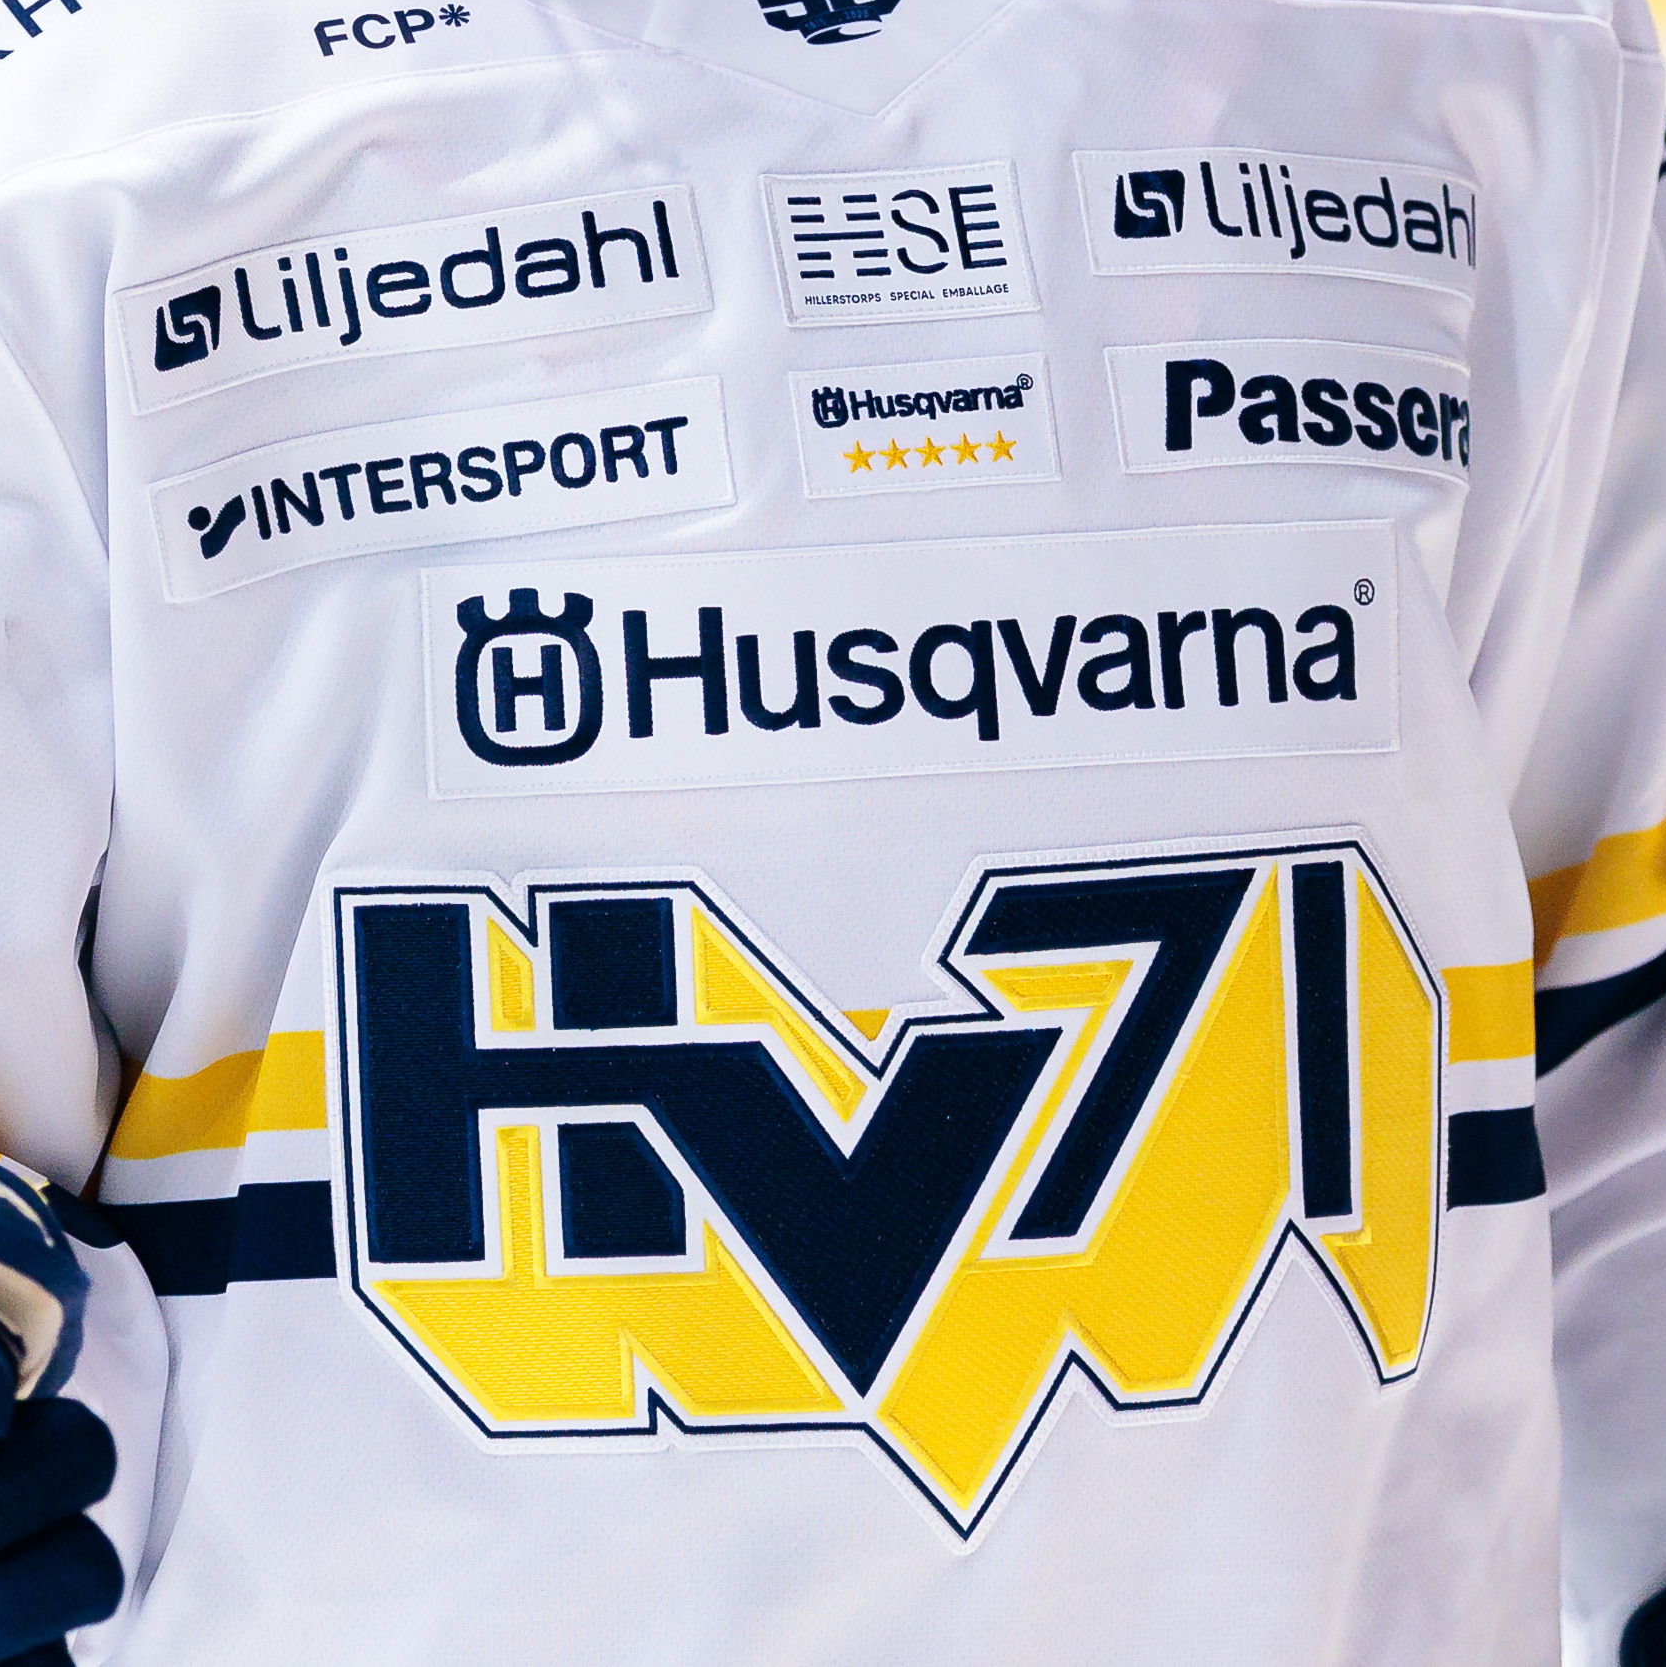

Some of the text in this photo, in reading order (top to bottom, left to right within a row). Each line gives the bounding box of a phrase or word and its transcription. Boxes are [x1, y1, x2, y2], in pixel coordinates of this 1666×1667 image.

[234, 200, 680, 347] Liljedahl
[787, 184, 1008, 280] HSE
[804, 283, 1009, 305] HILLERSTORPS SPECIAL EMBALLAGE
[250, 416, 689, 541] INTERSPORT
[349, 856, 1357, 1400] HV71
